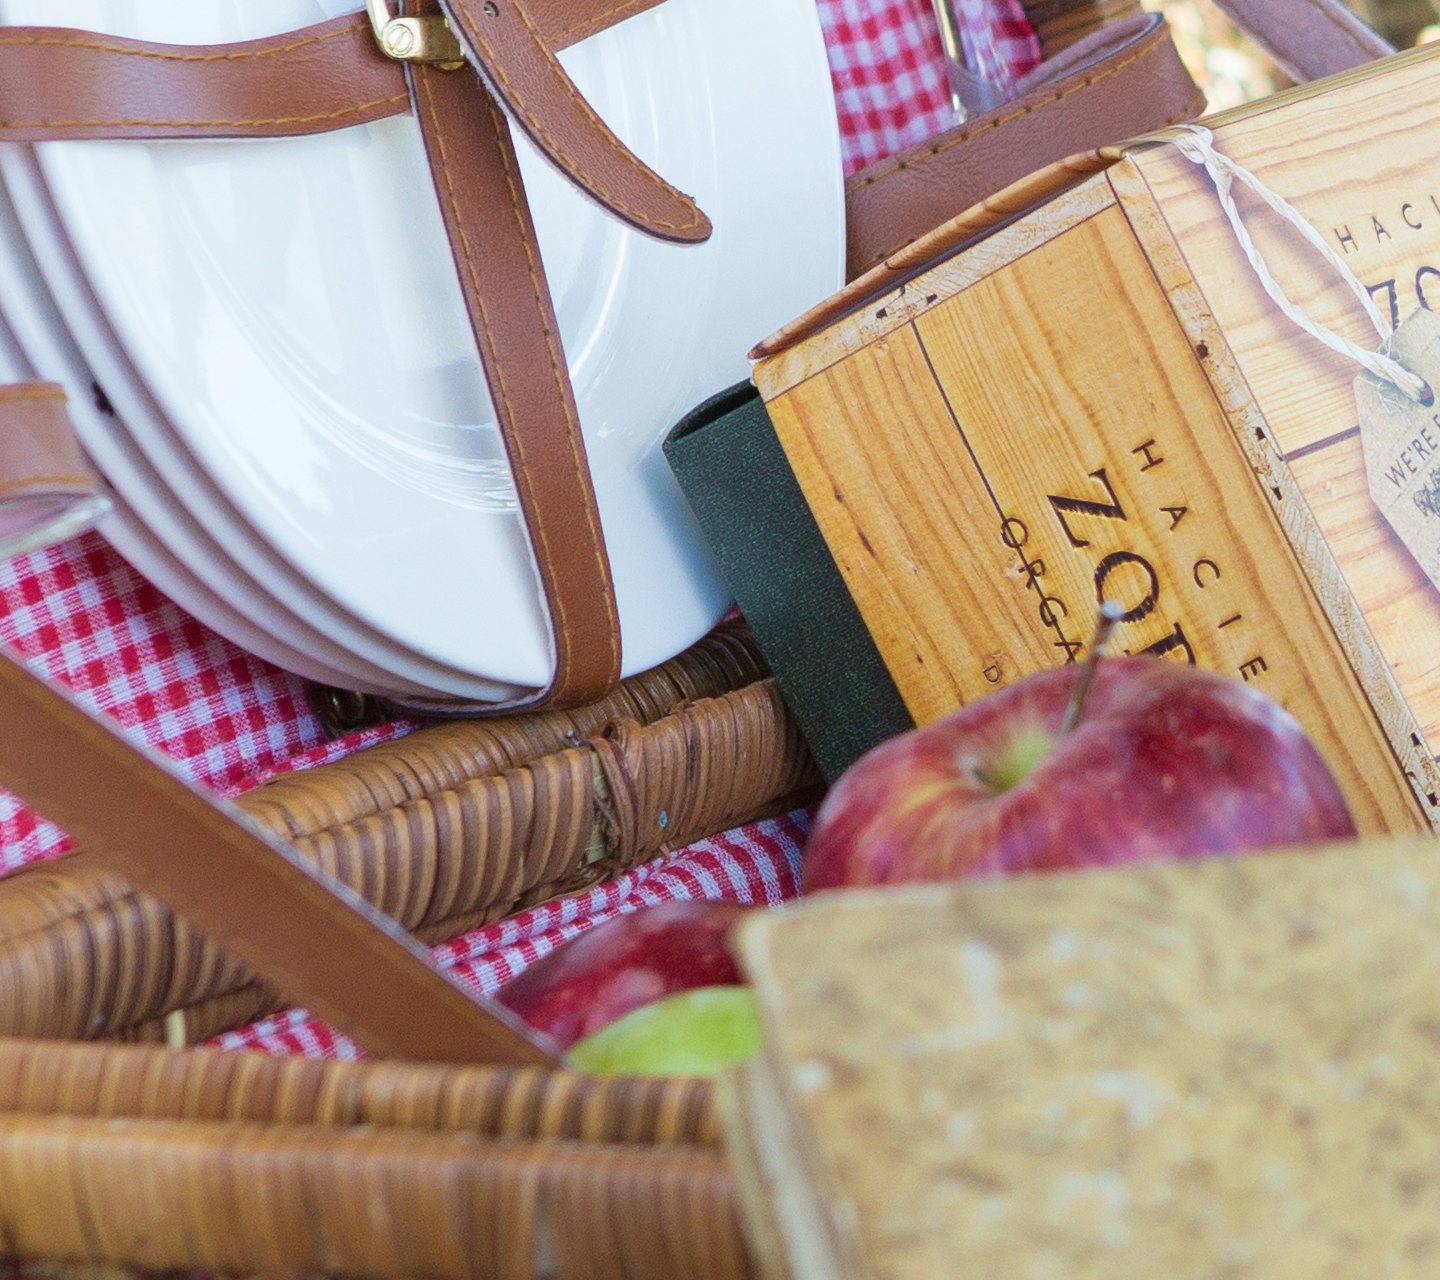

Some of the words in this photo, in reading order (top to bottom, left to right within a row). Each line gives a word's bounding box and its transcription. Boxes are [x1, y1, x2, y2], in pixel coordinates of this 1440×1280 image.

[1384, 428, 1439, 488] WE'RE
[1000, 518, 1083, 665] ORGA
[1131, 439, 1269, 682] HACIE
